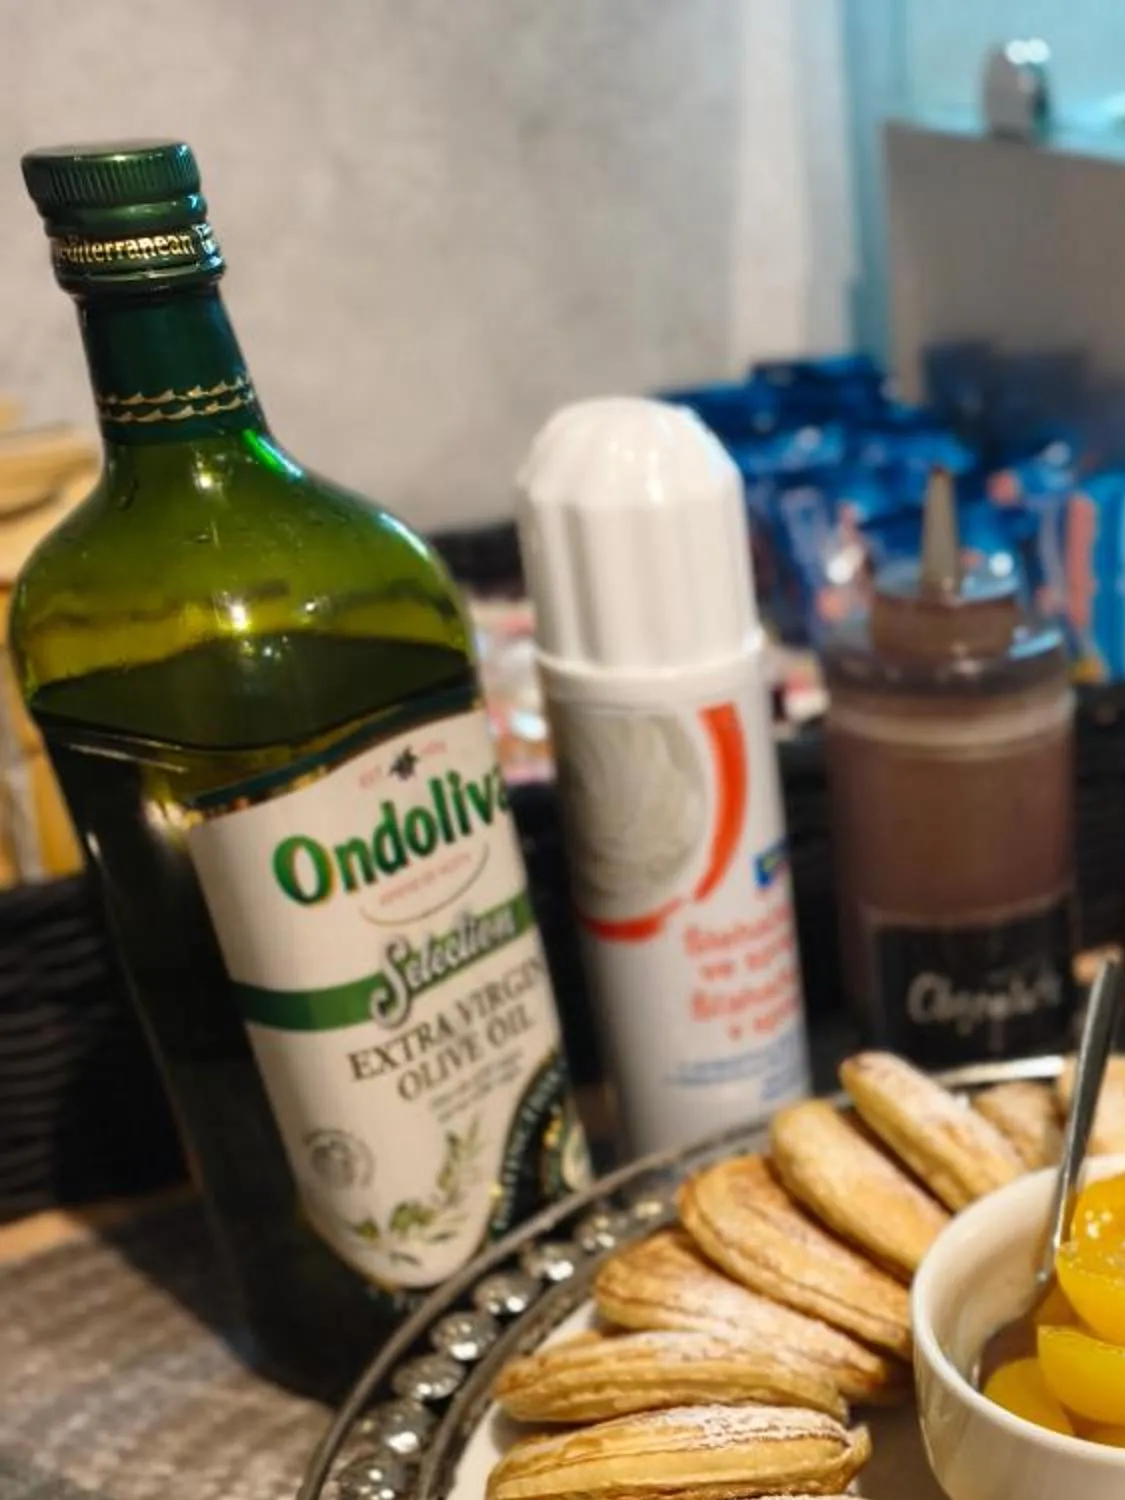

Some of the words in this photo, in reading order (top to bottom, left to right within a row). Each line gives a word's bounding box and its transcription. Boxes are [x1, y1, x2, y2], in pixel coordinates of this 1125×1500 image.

[57, 234, 196, 264] diterranean
[348, 1011, 455, 1082] EXTRA
[455, 954, 546, 1024] VIRGIN
[371, 908, 517, 1031] Selection
[396, 1031, 484, 1101] OLIVE
[486, 1002, 536, 1049] OIL
